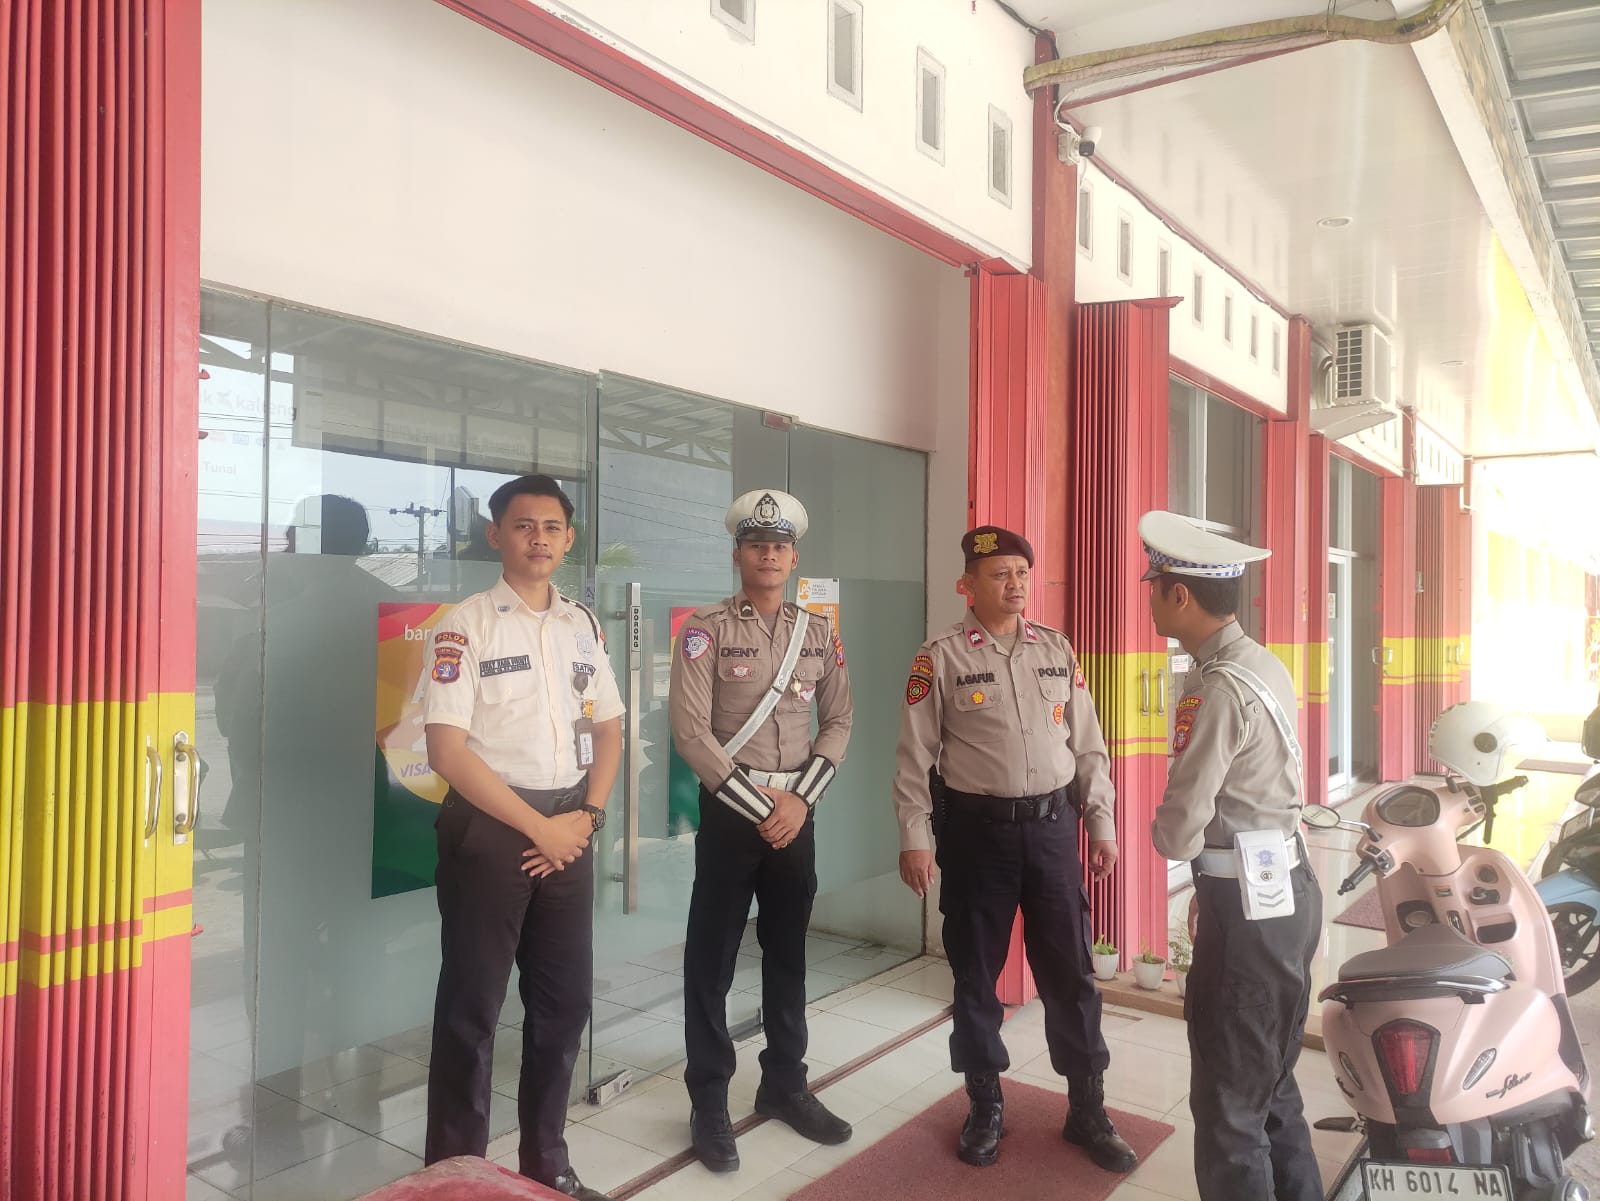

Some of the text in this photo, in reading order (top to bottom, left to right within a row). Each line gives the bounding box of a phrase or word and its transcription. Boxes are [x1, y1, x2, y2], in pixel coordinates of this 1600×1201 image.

[236, 392, 297, 421] kaleng
[437, 633, 466, 646] POLDA
[720, 647, 760, 658] DENY
[800, 647, 824, 658] OLRI
[956, 672, 996, 687] A.GAFUR
[1038, 666, 1068, 679] POLRI
[400, 761, 432, 779] VISA
[1368, 1167, 1503, 1197] KH 6014 NA
